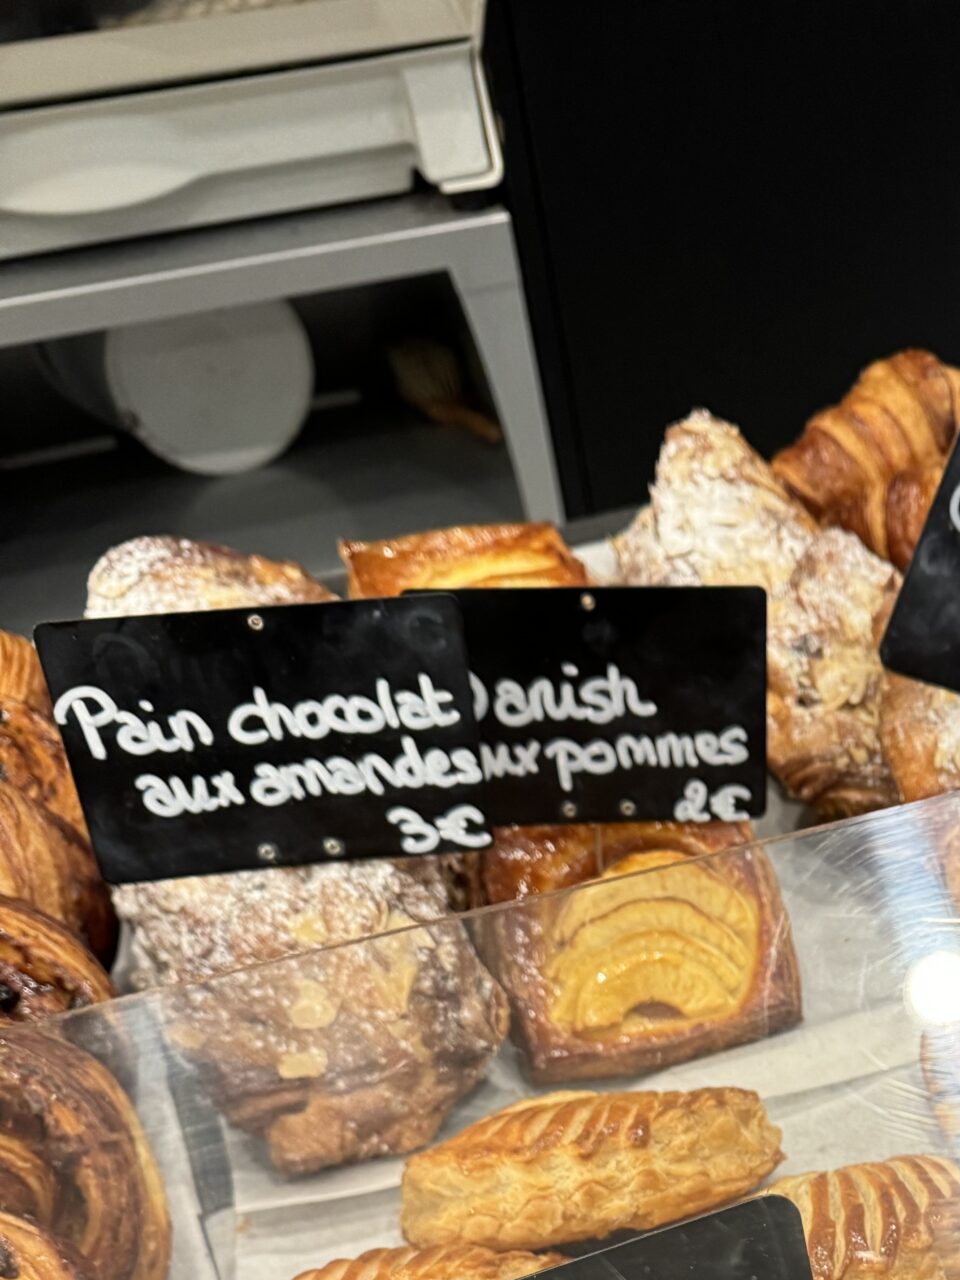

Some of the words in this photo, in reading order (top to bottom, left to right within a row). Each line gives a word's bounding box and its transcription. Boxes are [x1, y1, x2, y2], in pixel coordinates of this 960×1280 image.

[53, 685, 214, 760] Pain
[228, 673, 461, 745] chocolat
[134, 770, 246, 818] aux
[250, 735, 483, 806] amandes
[479, 738, 541, 782] ux
[545, 726, 749, 792] pommes
[386, 804, 493, 854] 3€
[674, 779, 752, 823] 2€
